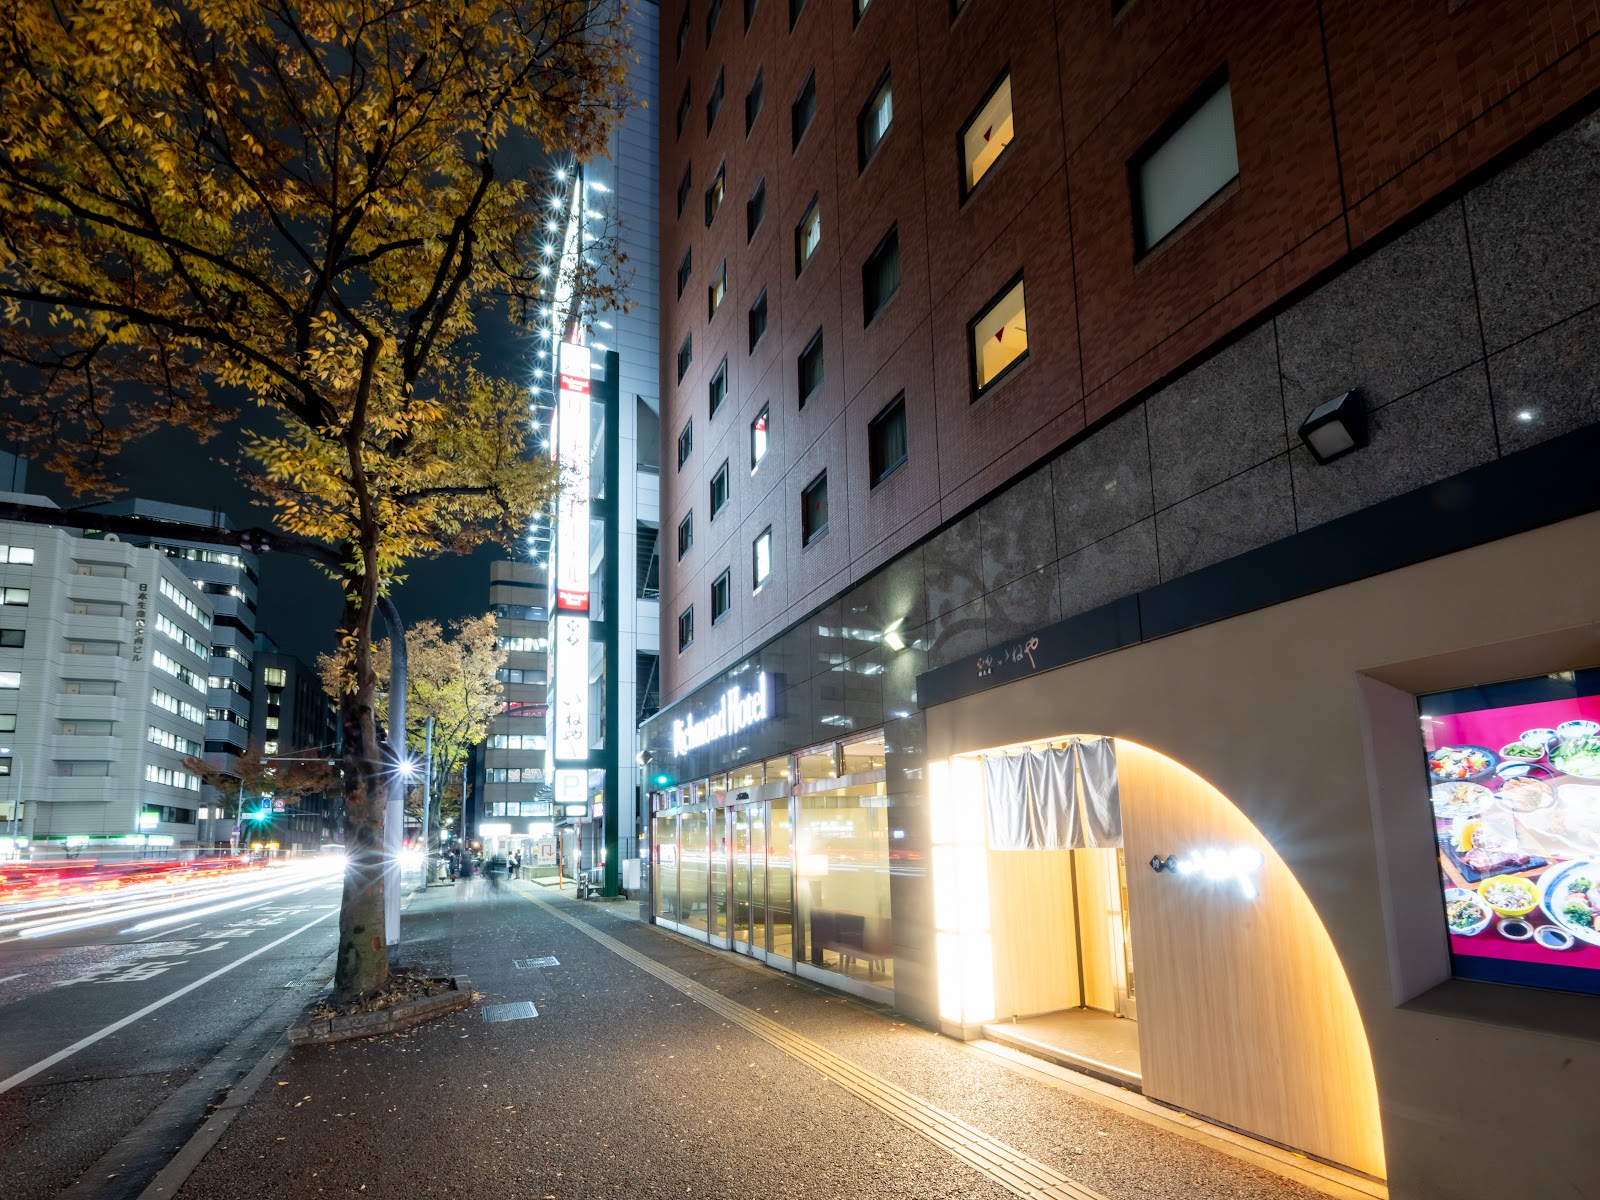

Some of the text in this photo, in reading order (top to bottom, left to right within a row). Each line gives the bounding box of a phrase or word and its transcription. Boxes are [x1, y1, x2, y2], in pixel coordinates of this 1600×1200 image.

[563, 694, 583, 757] いねや
[673, 671, 767, 758] Richmond Hotel
[563, 775, 580, 797] P
